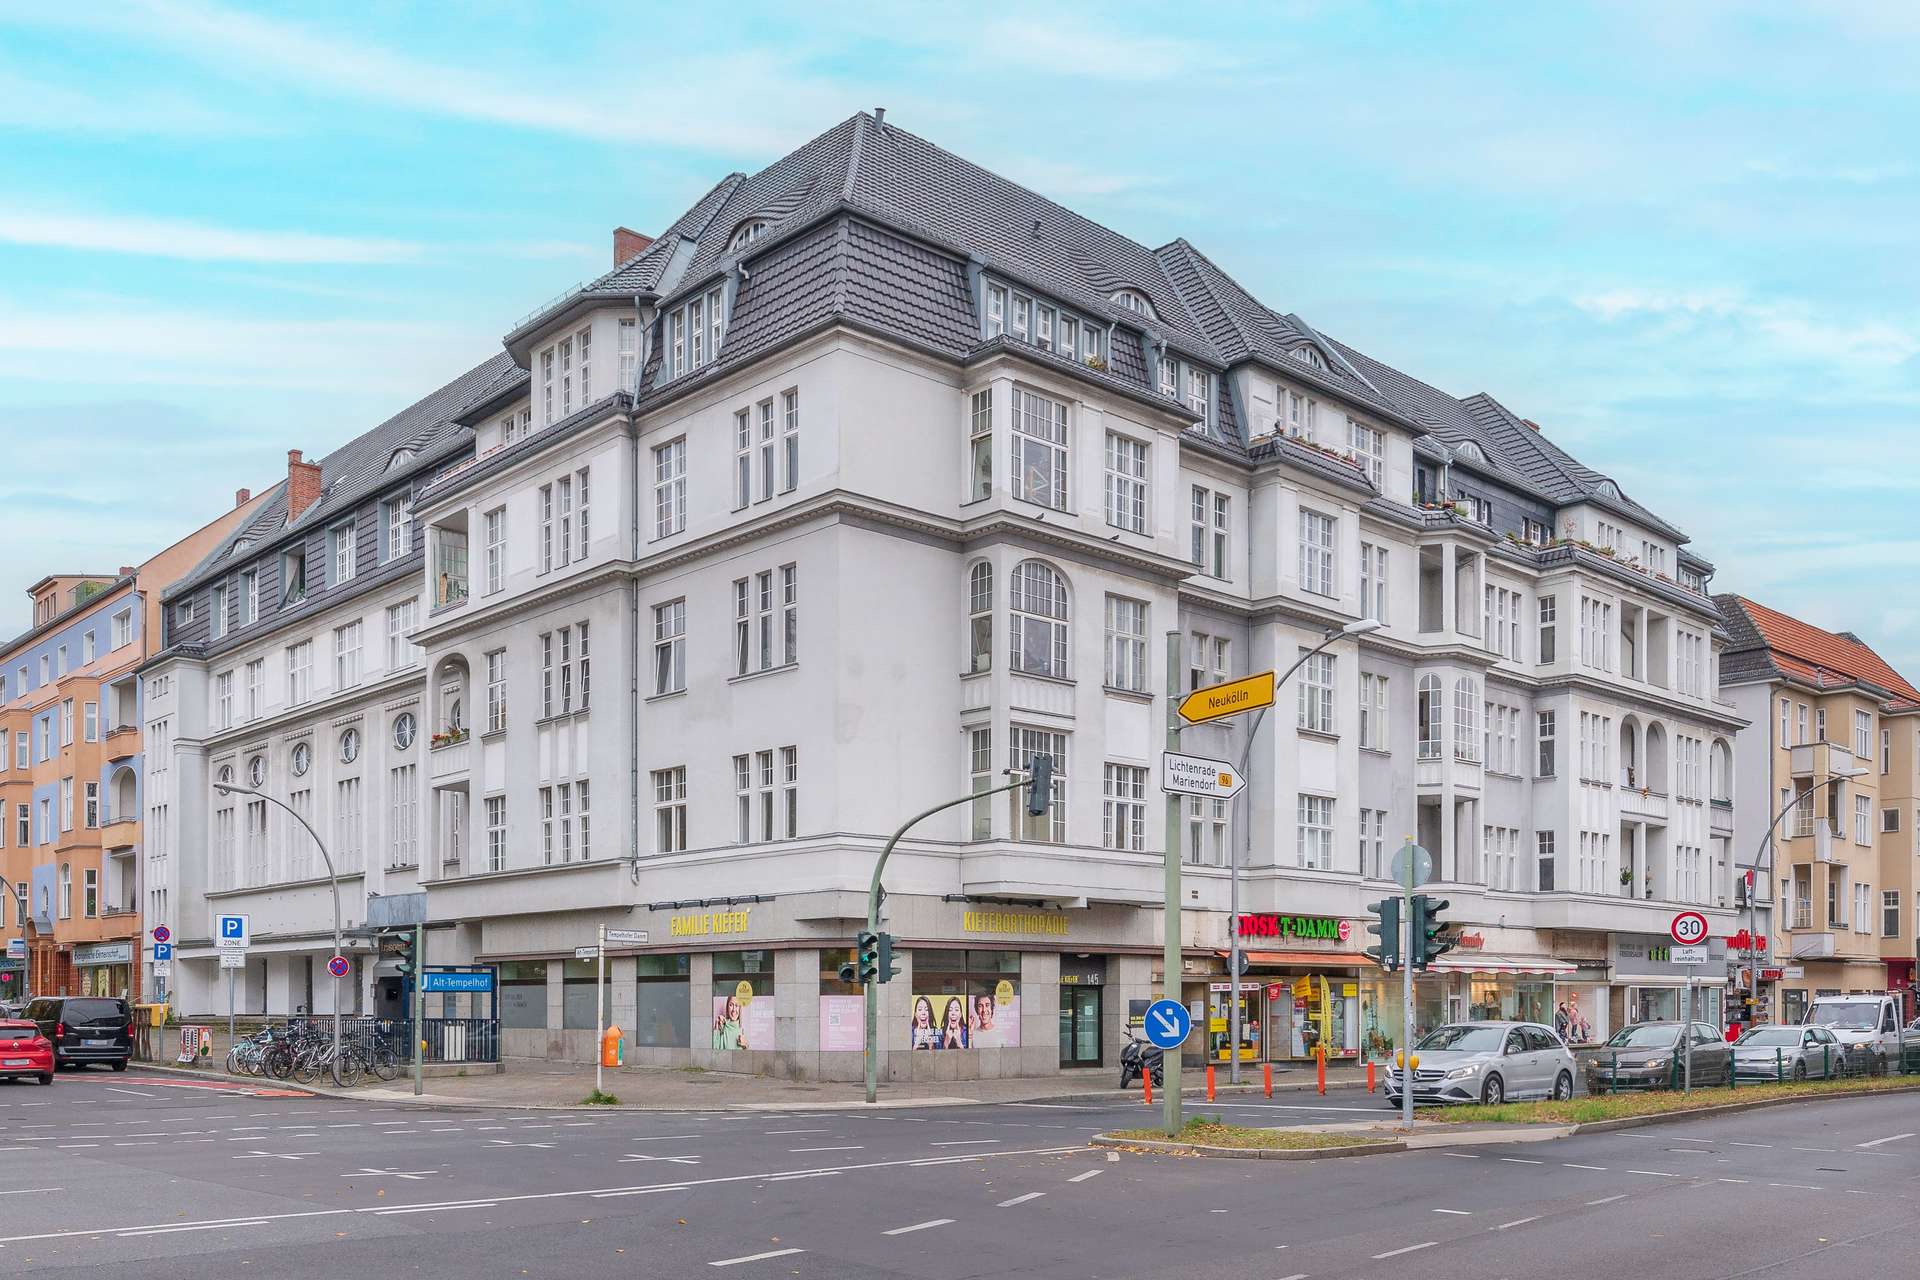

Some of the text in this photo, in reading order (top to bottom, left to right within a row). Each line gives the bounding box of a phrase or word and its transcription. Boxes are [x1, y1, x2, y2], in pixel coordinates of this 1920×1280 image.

[1208, 690, 1249, 710] Neukölln
[1169, 759, 1216, 777] Lichtenrade
[1172, 773, 1216, 791] Mariendorf
[1221, 775, 1229, 785] 96
[227, 920, 238, 935] P
[671, 911, 747, 937] FAMILIE KIEFER
[1679, 920, 1700, 935] 30
[1461, 930, 1485, 950] family
[157, 945, 168, 958] P
[1674, 955, 1704, 963] reinhaltung
[432, 977, 488, 989] Alt-Tempelhof
[1087, 973, 1099, 985] 145
